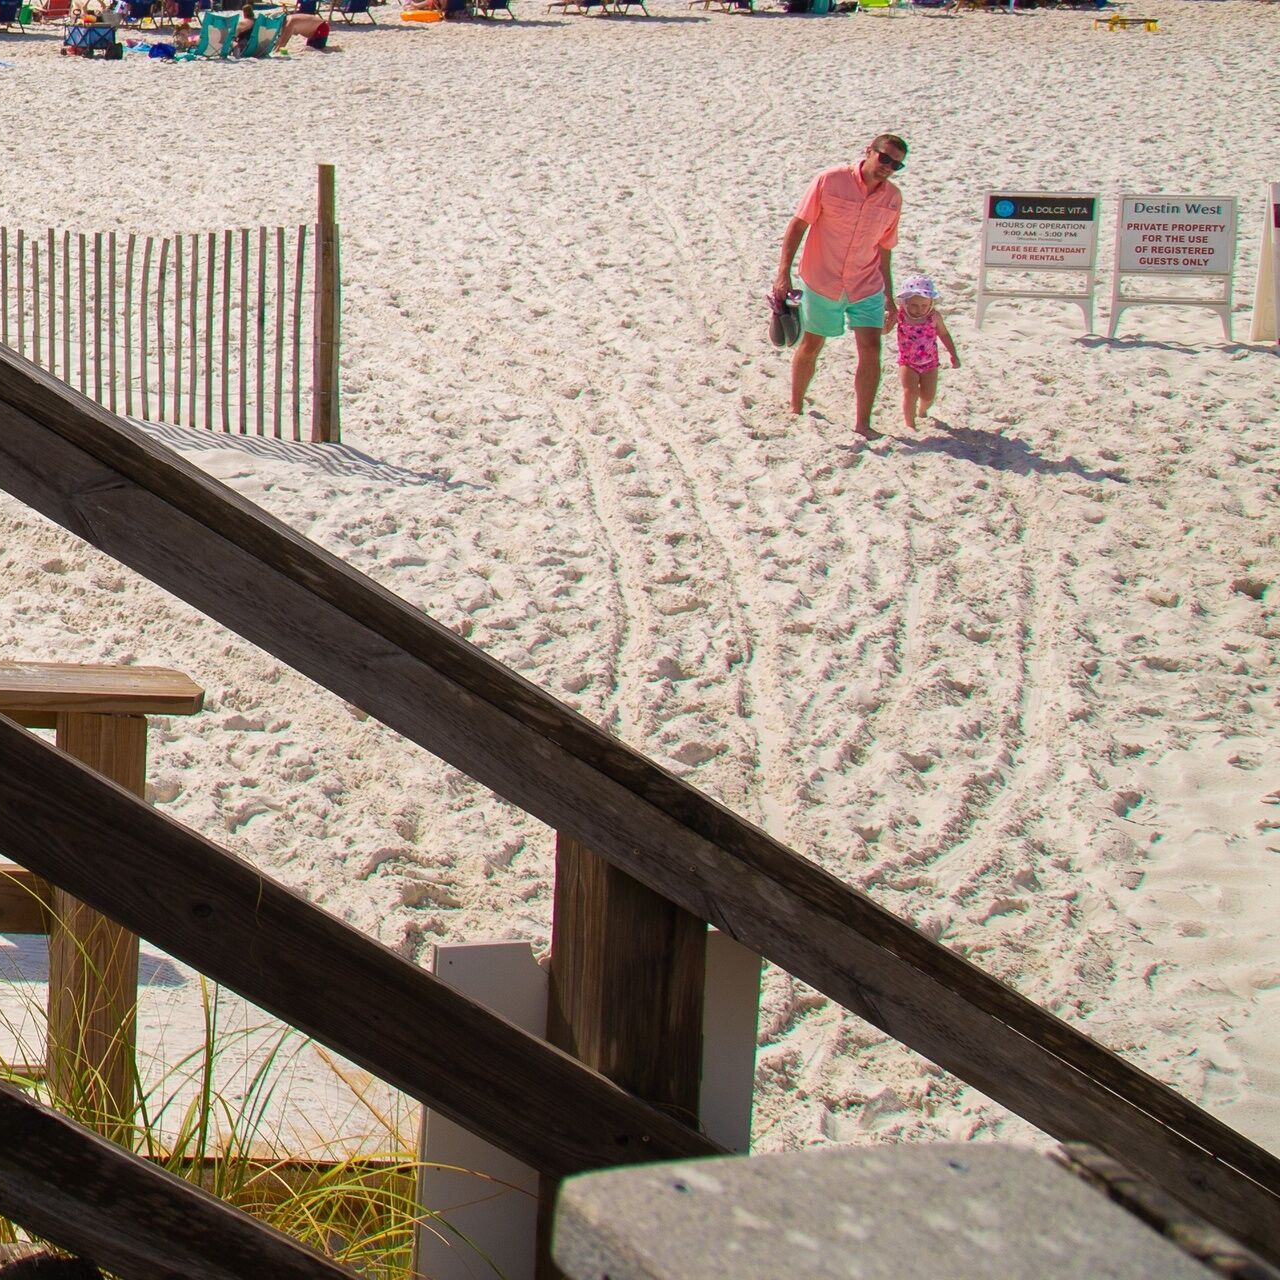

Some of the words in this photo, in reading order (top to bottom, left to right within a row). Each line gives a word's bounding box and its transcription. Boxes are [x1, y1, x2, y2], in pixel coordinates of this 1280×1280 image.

[1134, 201, 1180, 214] Destin
[1184, 202, 1222, 215] West
[1127, 223, 1168, 231] PRIVATE
[1171, 223, 1225, 232] PROPERTY
[1142, 234, 1162, 242] FOR
[1165, 235, 1185, 243] THE
[1135, 246, 1148, 254] OF
[1151, 246, 1214, 255] REGISTERED
[1139, 257, 1179, 265] GUESTS
[1182, 258, 1209, 266] ONLY
